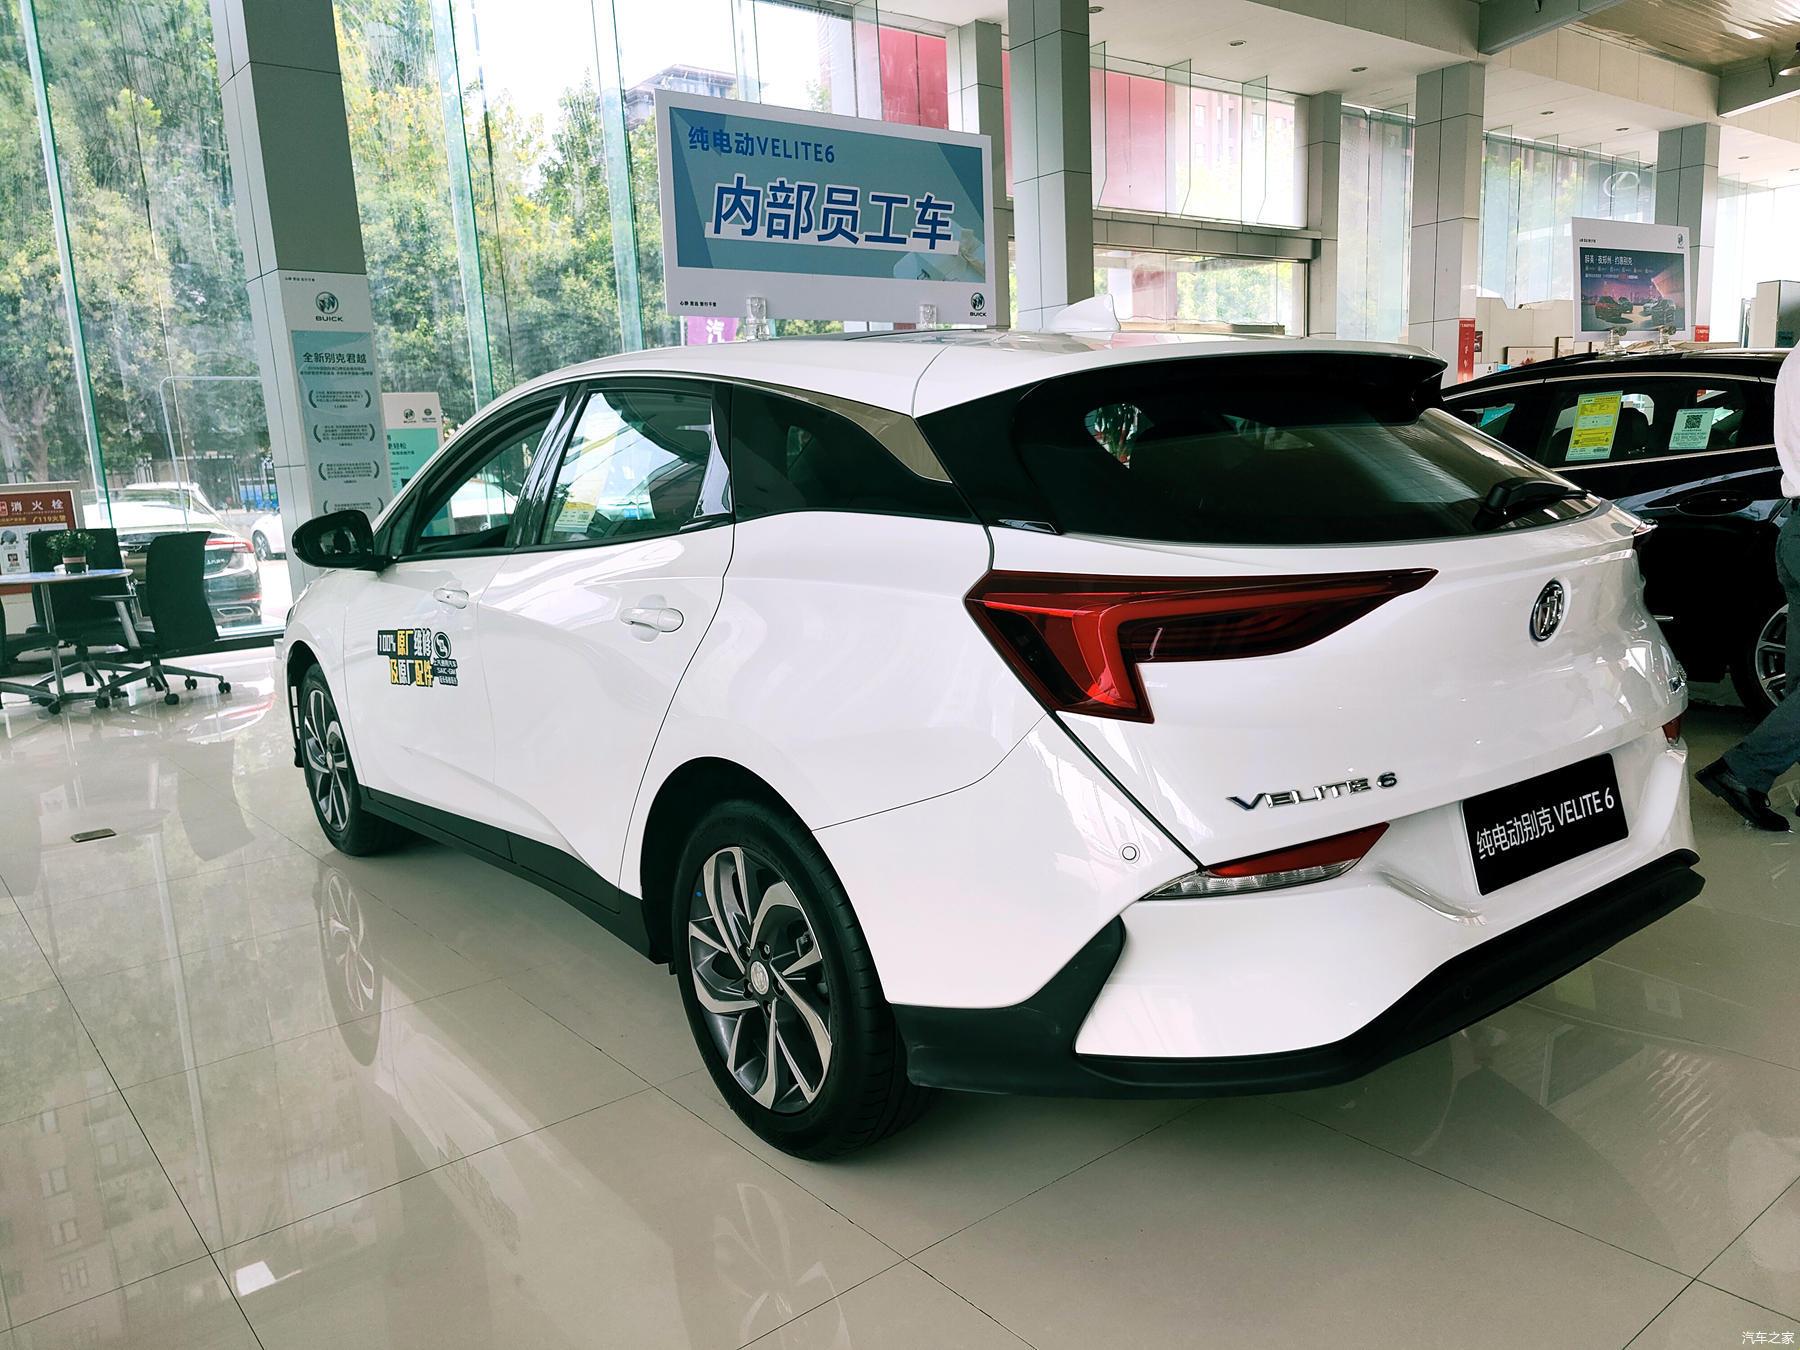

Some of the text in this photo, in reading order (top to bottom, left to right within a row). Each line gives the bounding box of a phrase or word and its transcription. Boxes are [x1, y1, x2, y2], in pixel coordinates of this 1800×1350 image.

[688, 126, 835, 163] 纯电动VELITE6
[712, 174, 954, 250] 内部员工车
[303, 352, 367, 364] 全新别克君越
[11, 499, 64, 512] 消火栓
[1226, 771, 1398, 811] VELITE 6
[1476, 787, 1615, 860] 纯电动别克 VELITE 6
